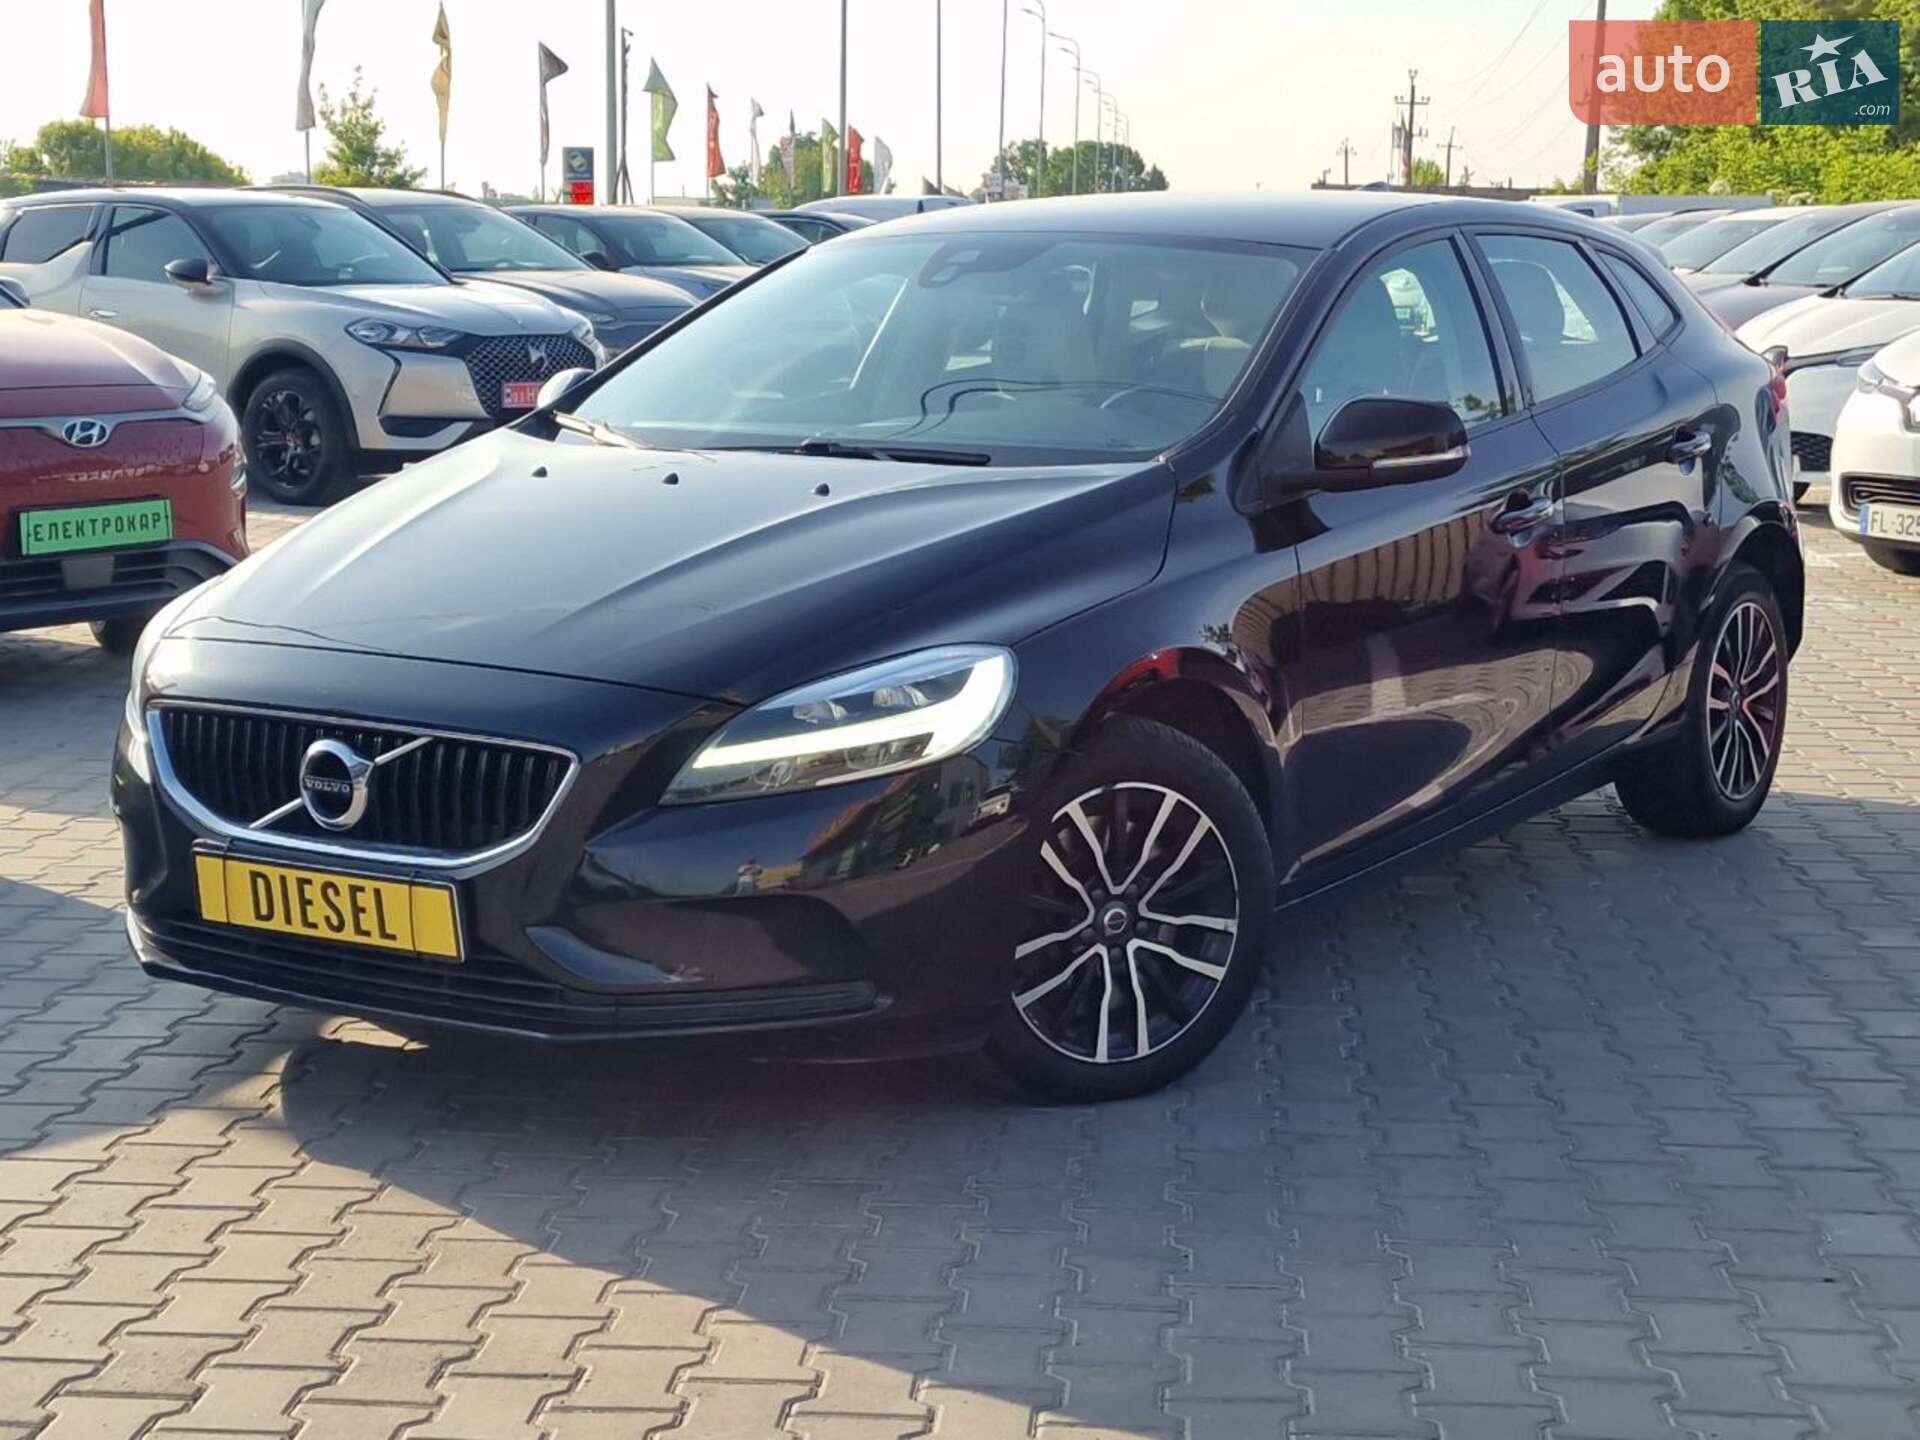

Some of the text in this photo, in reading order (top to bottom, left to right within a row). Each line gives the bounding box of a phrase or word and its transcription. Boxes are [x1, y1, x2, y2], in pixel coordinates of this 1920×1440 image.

[33, 512, 162, 542] ЕЛЕКТРОКАР
[304, 778, 350, 793] VOLVO
[249, 869, 398, 941] DIESEL
